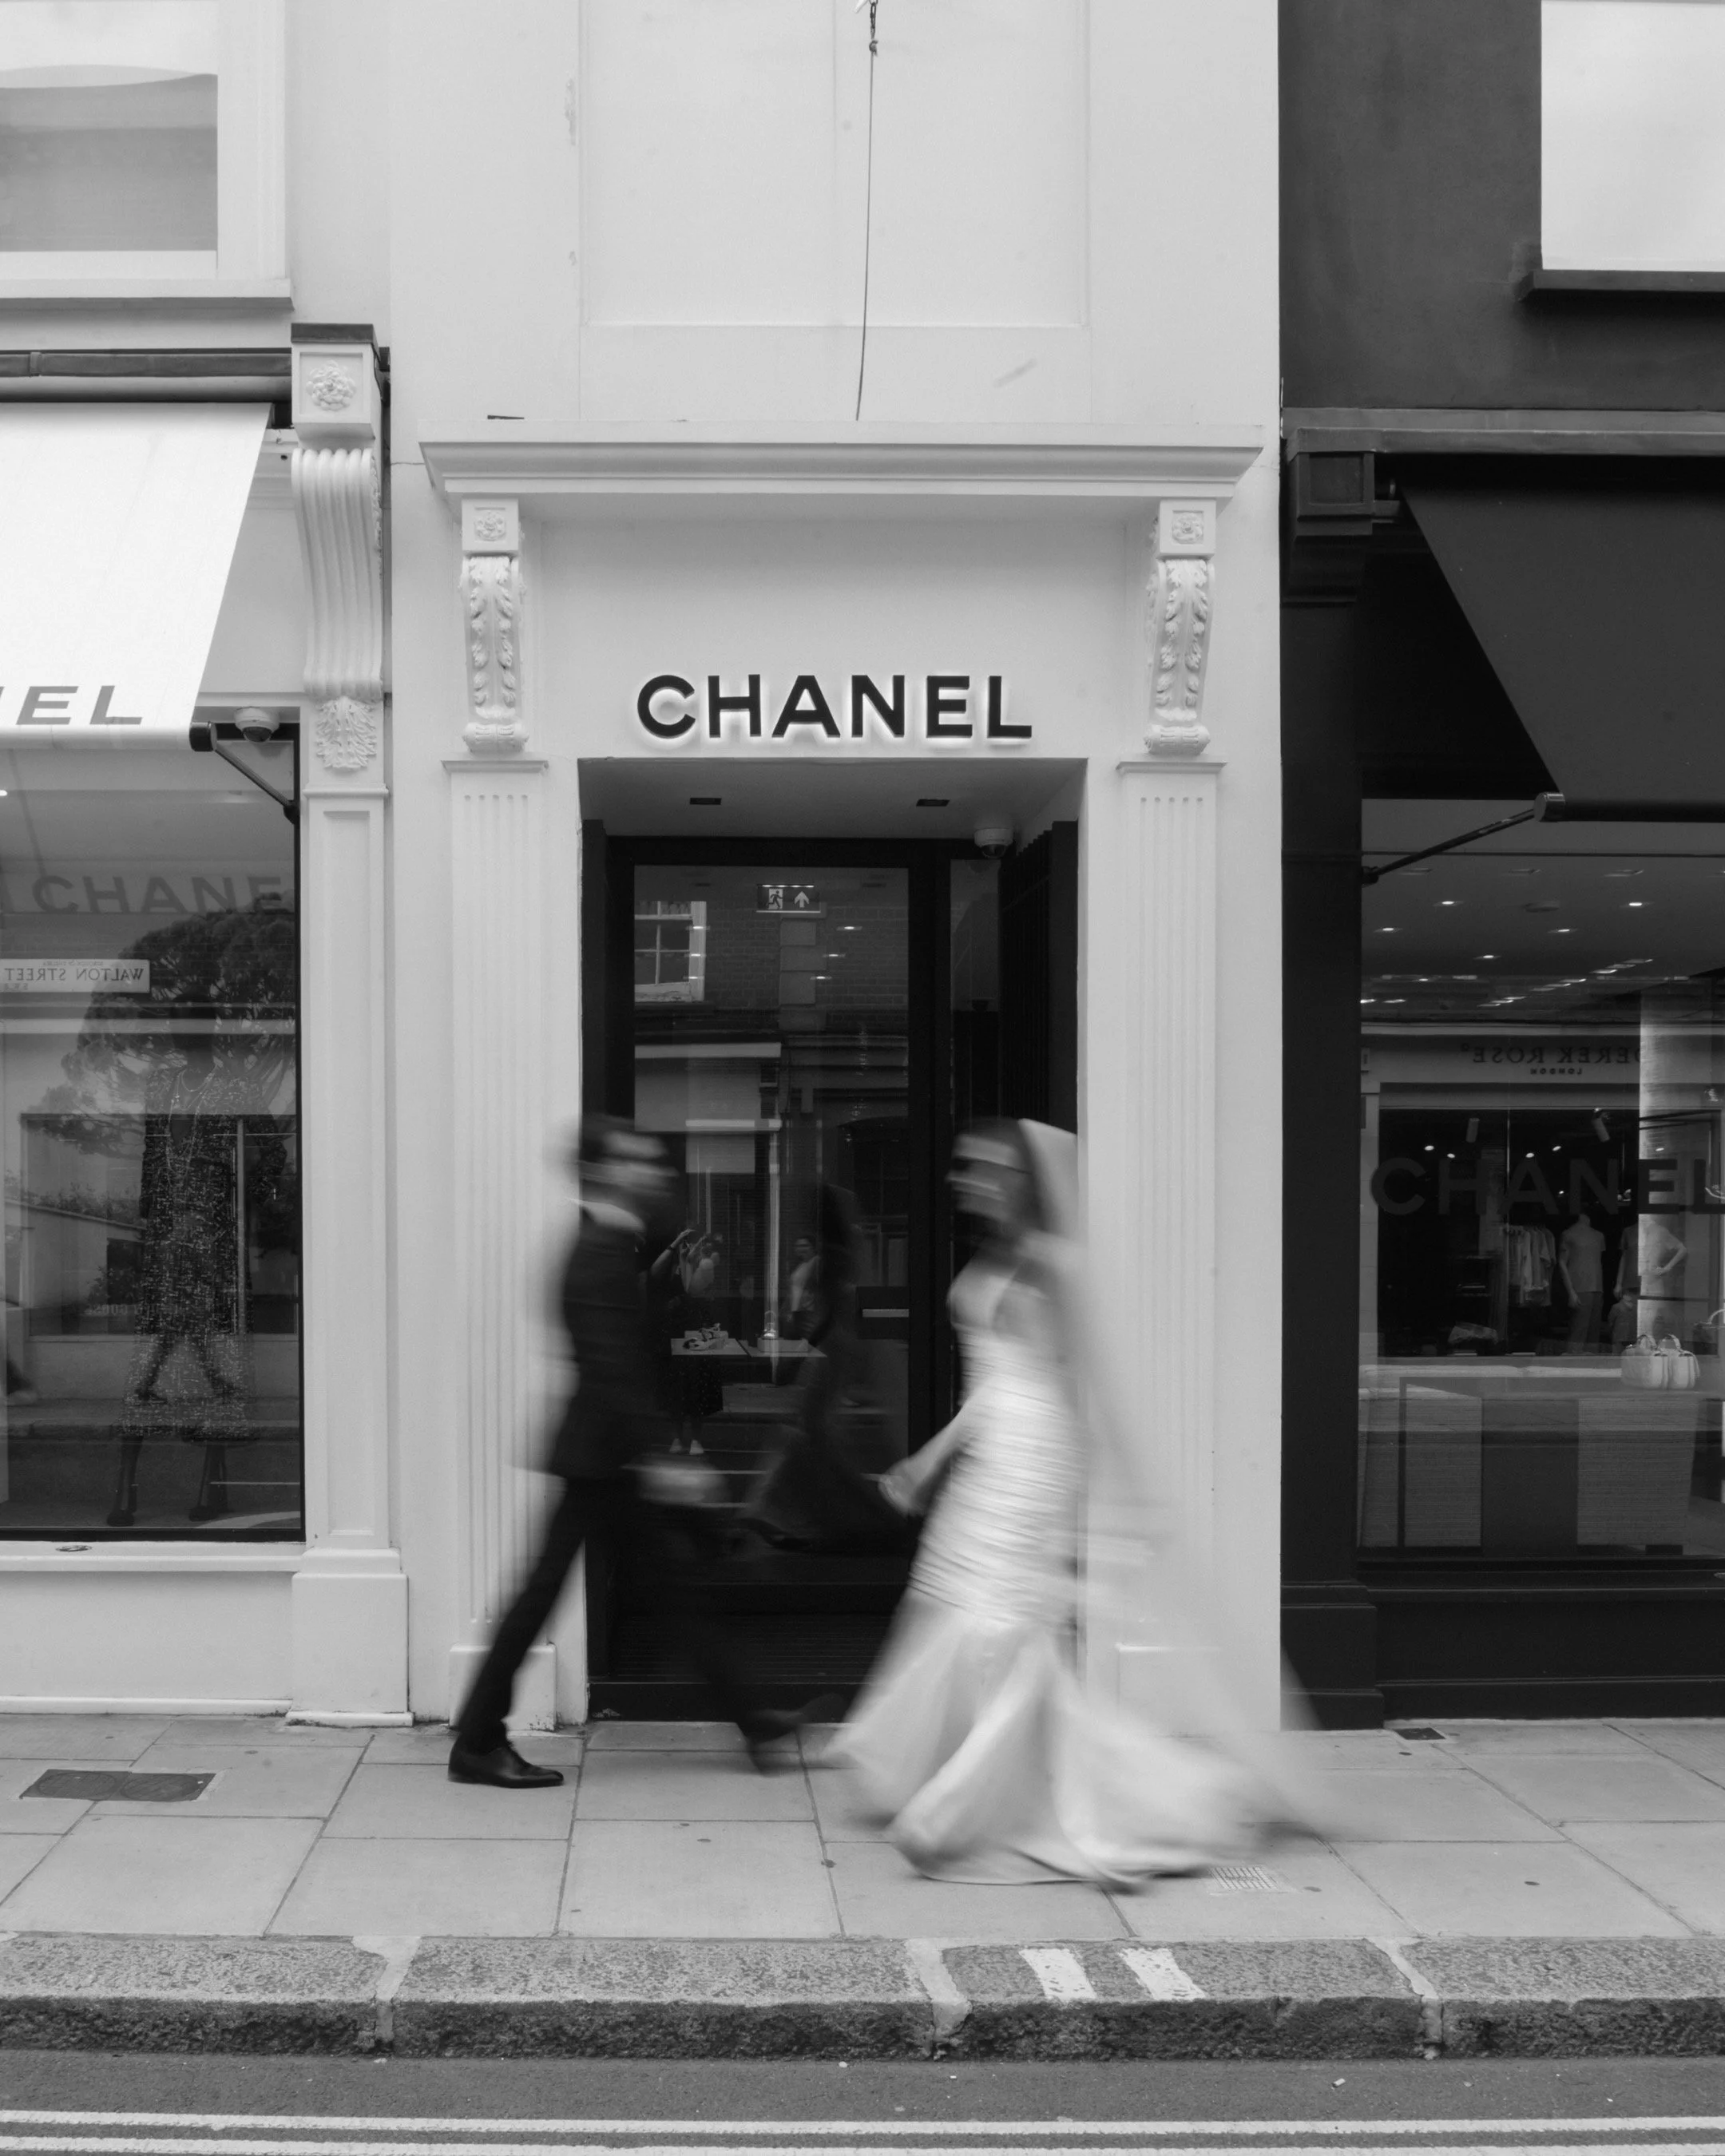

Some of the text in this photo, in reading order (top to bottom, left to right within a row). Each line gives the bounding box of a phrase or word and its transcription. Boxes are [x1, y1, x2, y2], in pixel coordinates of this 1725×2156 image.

[0, 686, 142, 725] EL
[637, 674, 1033, 739] CHANEL
[1370, 1157, 1725, 1215] CHANEL
